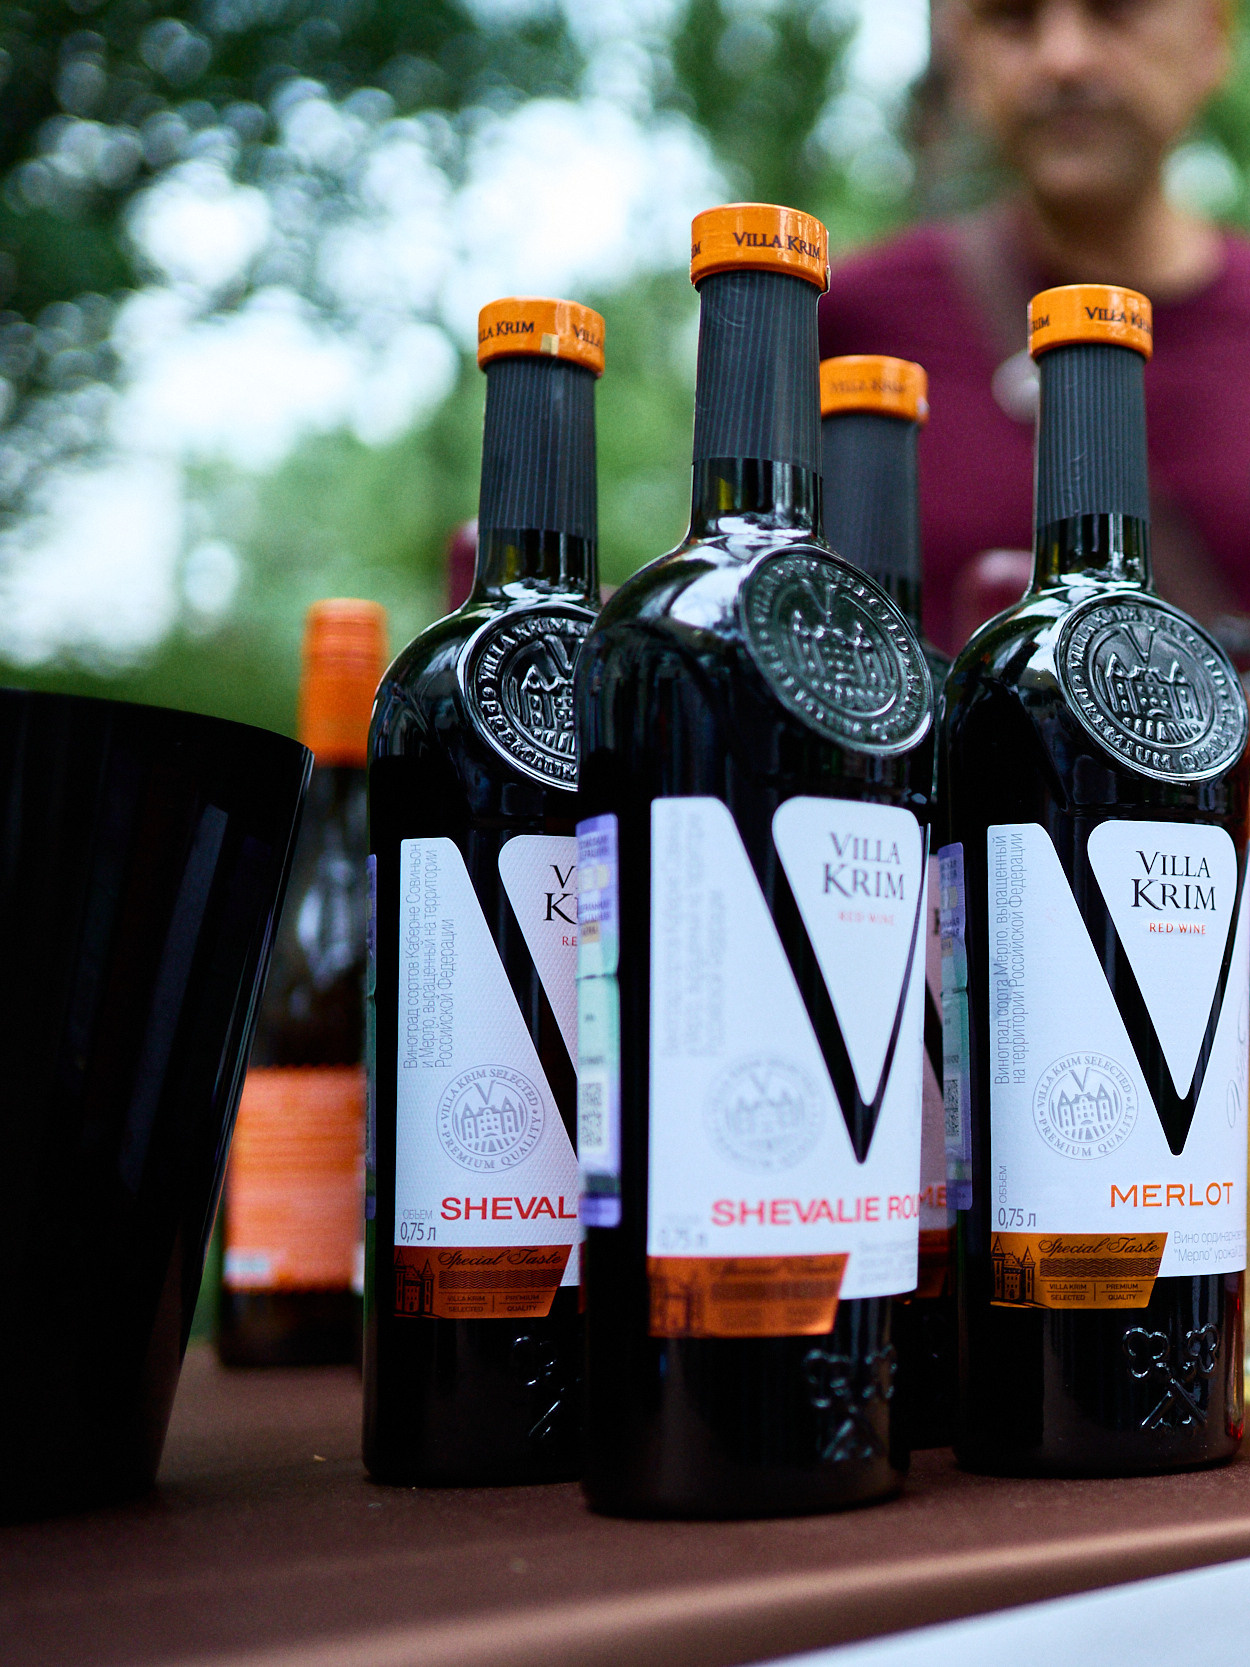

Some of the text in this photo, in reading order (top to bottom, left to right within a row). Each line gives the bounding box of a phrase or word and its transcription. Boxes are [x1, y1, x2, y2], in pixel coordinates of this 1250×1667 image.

[732, 231, 820, 259] VILLA KRIM
[496, 321, 535, 337] KRIM
[1084, 306, 1127, 324] VILLA
[830, 831, 900, 865] VILLA
[992, 835, 1010, 924] выращенный
[1136, 850, 1211, 878] VILLA
[424, 850, 441, 919] территории
[823, 863, 905, 900] KRIM
[1131, 878, 1216, 911] KRIM
[424, 921, 436, 935] на
[562, 936, 578, 947] RE
[1149, 922, 1206, 935] RED WINE
[403, 844, 423, 1068] Виноград сортов Каберне Совиньон
[1008, 833, 1029, 1084] на территории Российской Федерации
[420, 939, 438, 1012] выращенный
[435, 919, 458, 1068] Российской Федерации
[996, 978, 1012, 1016] сорта
[994, 1019, 1013, 1084] Виноград
[441, 1068, 538, 1121] VILLA KRIM SELECTED
[1037, 1055, 1131, 1108] VILLA KRIM SELECTED
[442, 1116, 541, 1168] PREMIUM QUALITY
[1039, 1104, 1135, 1157] PREMIUM QUALITY
[998, 1165, 1007, 1203] ОБЪЕМ
[1110, 1182, 1233, 1208] MERLOT
[402, 1209, 433, 1220] ОБЪЕМ
[440, 1196, 577, 1220] SHEVAL
[711, 1196, 880, 1227] SHEVALIE
[998, 1207, 1036, 1229] 0,75 л
[400, 1222, 436, 1243] 0,75 л
[1038, 1237, 1160, 1257] Special Taste
[1174, 1231, 1199, 1244] Вино
[438, 1249, 562, 1268] Special Taste
[507, 1304, 537, 1312] QUALITY
